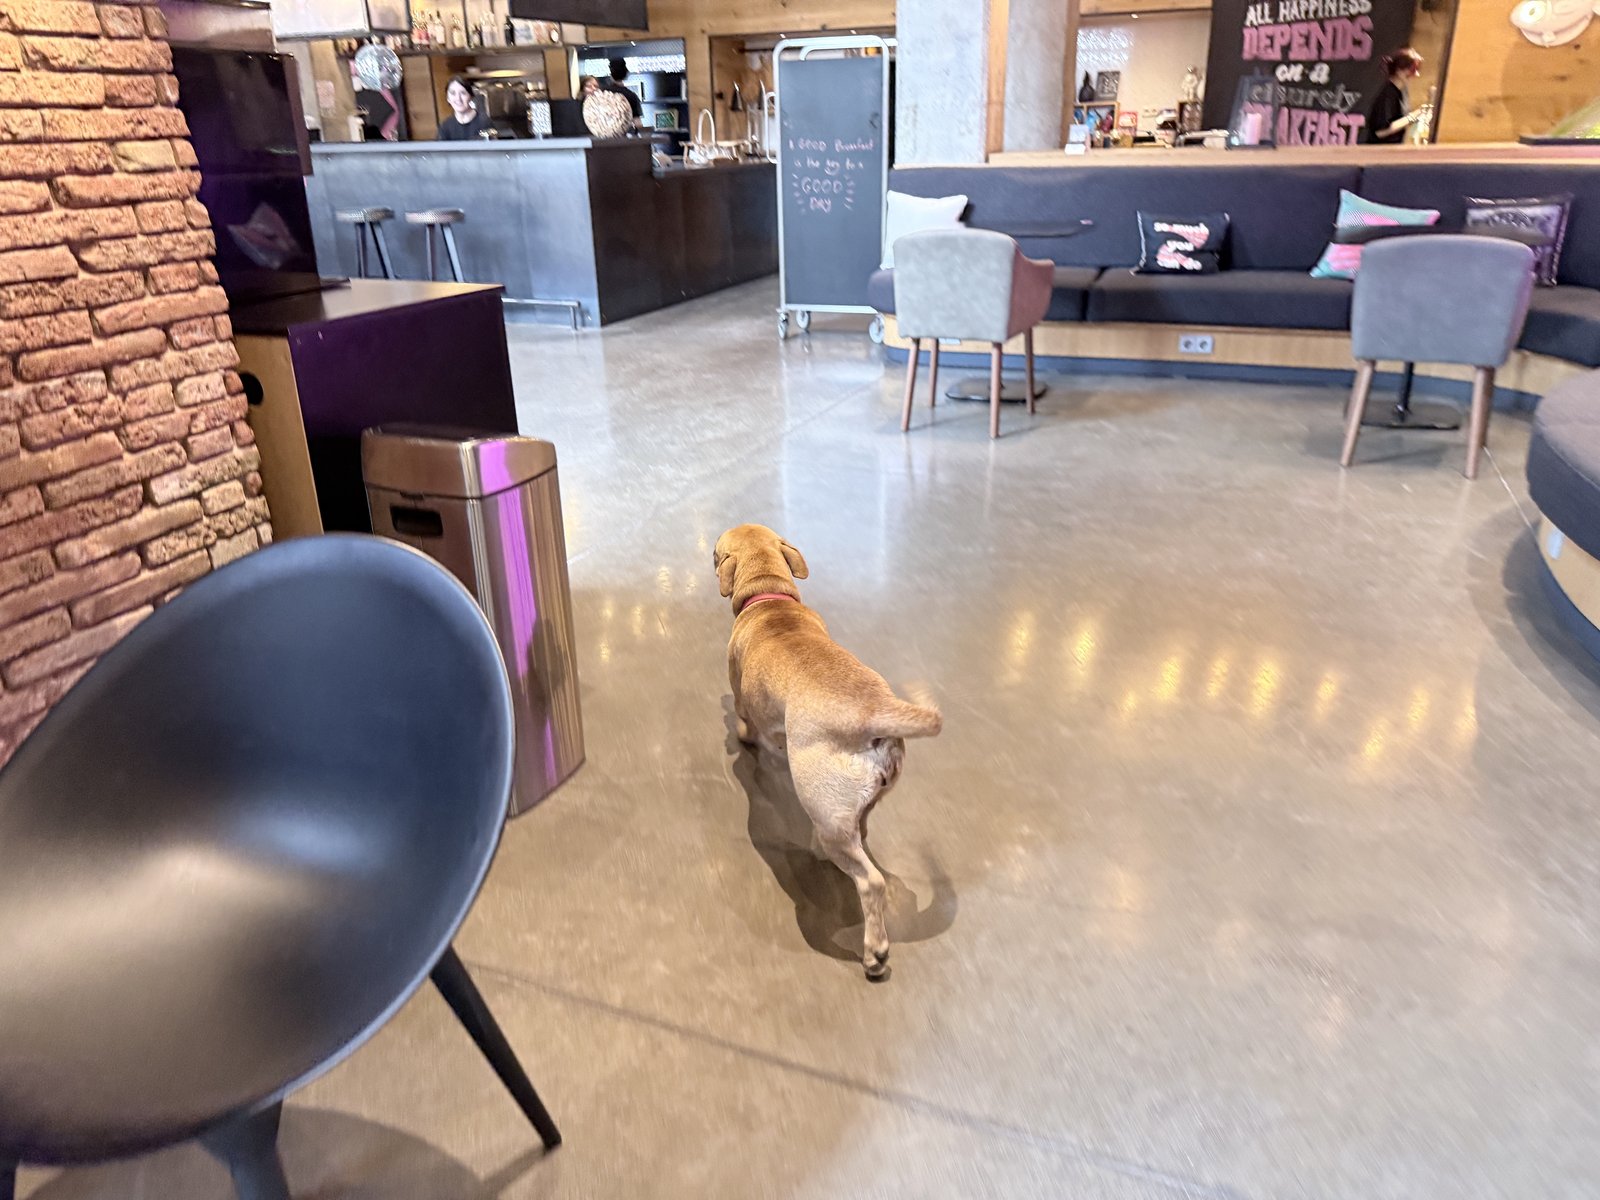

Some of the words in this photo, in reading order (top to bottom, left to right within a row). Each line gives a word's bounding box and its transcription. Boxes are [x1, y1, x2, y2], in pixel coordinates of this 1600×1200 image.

[1244, 3, 1273, 27] ALL
[1278, 0, 1372, 22] HAPPINESS
[1242, 15, 1374, 61] DEPENDS
[1275, 63, 1304, 82] on
[801, 177, 843, 194] GOOD
[810, 197, 832, 213] DAY
